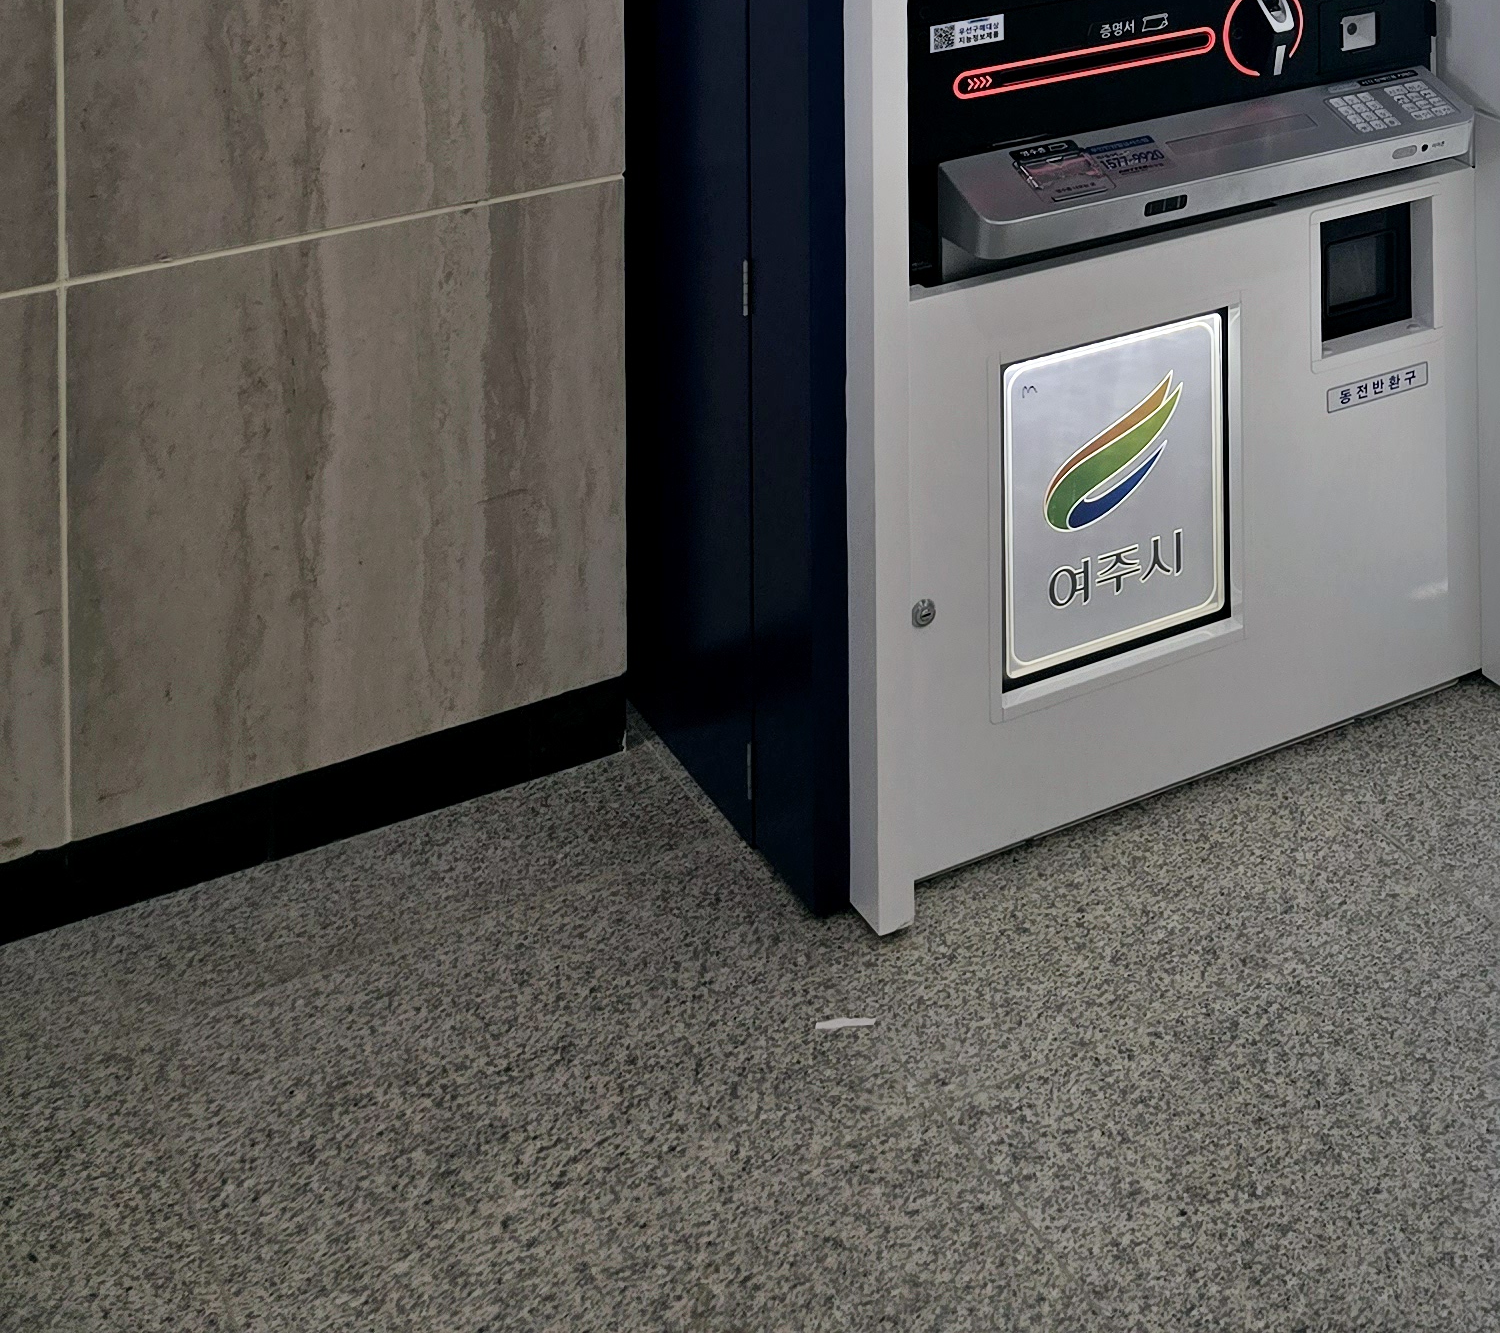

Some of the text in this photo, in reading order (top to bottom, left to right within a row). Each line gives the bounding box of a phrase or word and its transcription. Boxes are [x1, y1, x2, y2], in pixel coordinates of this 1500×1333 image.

[1099, 20, 1136, 38] 증명서
[1100, 149, 1165, 171] 1577-9920
[1047, 528, 1184, 612] 여주시
